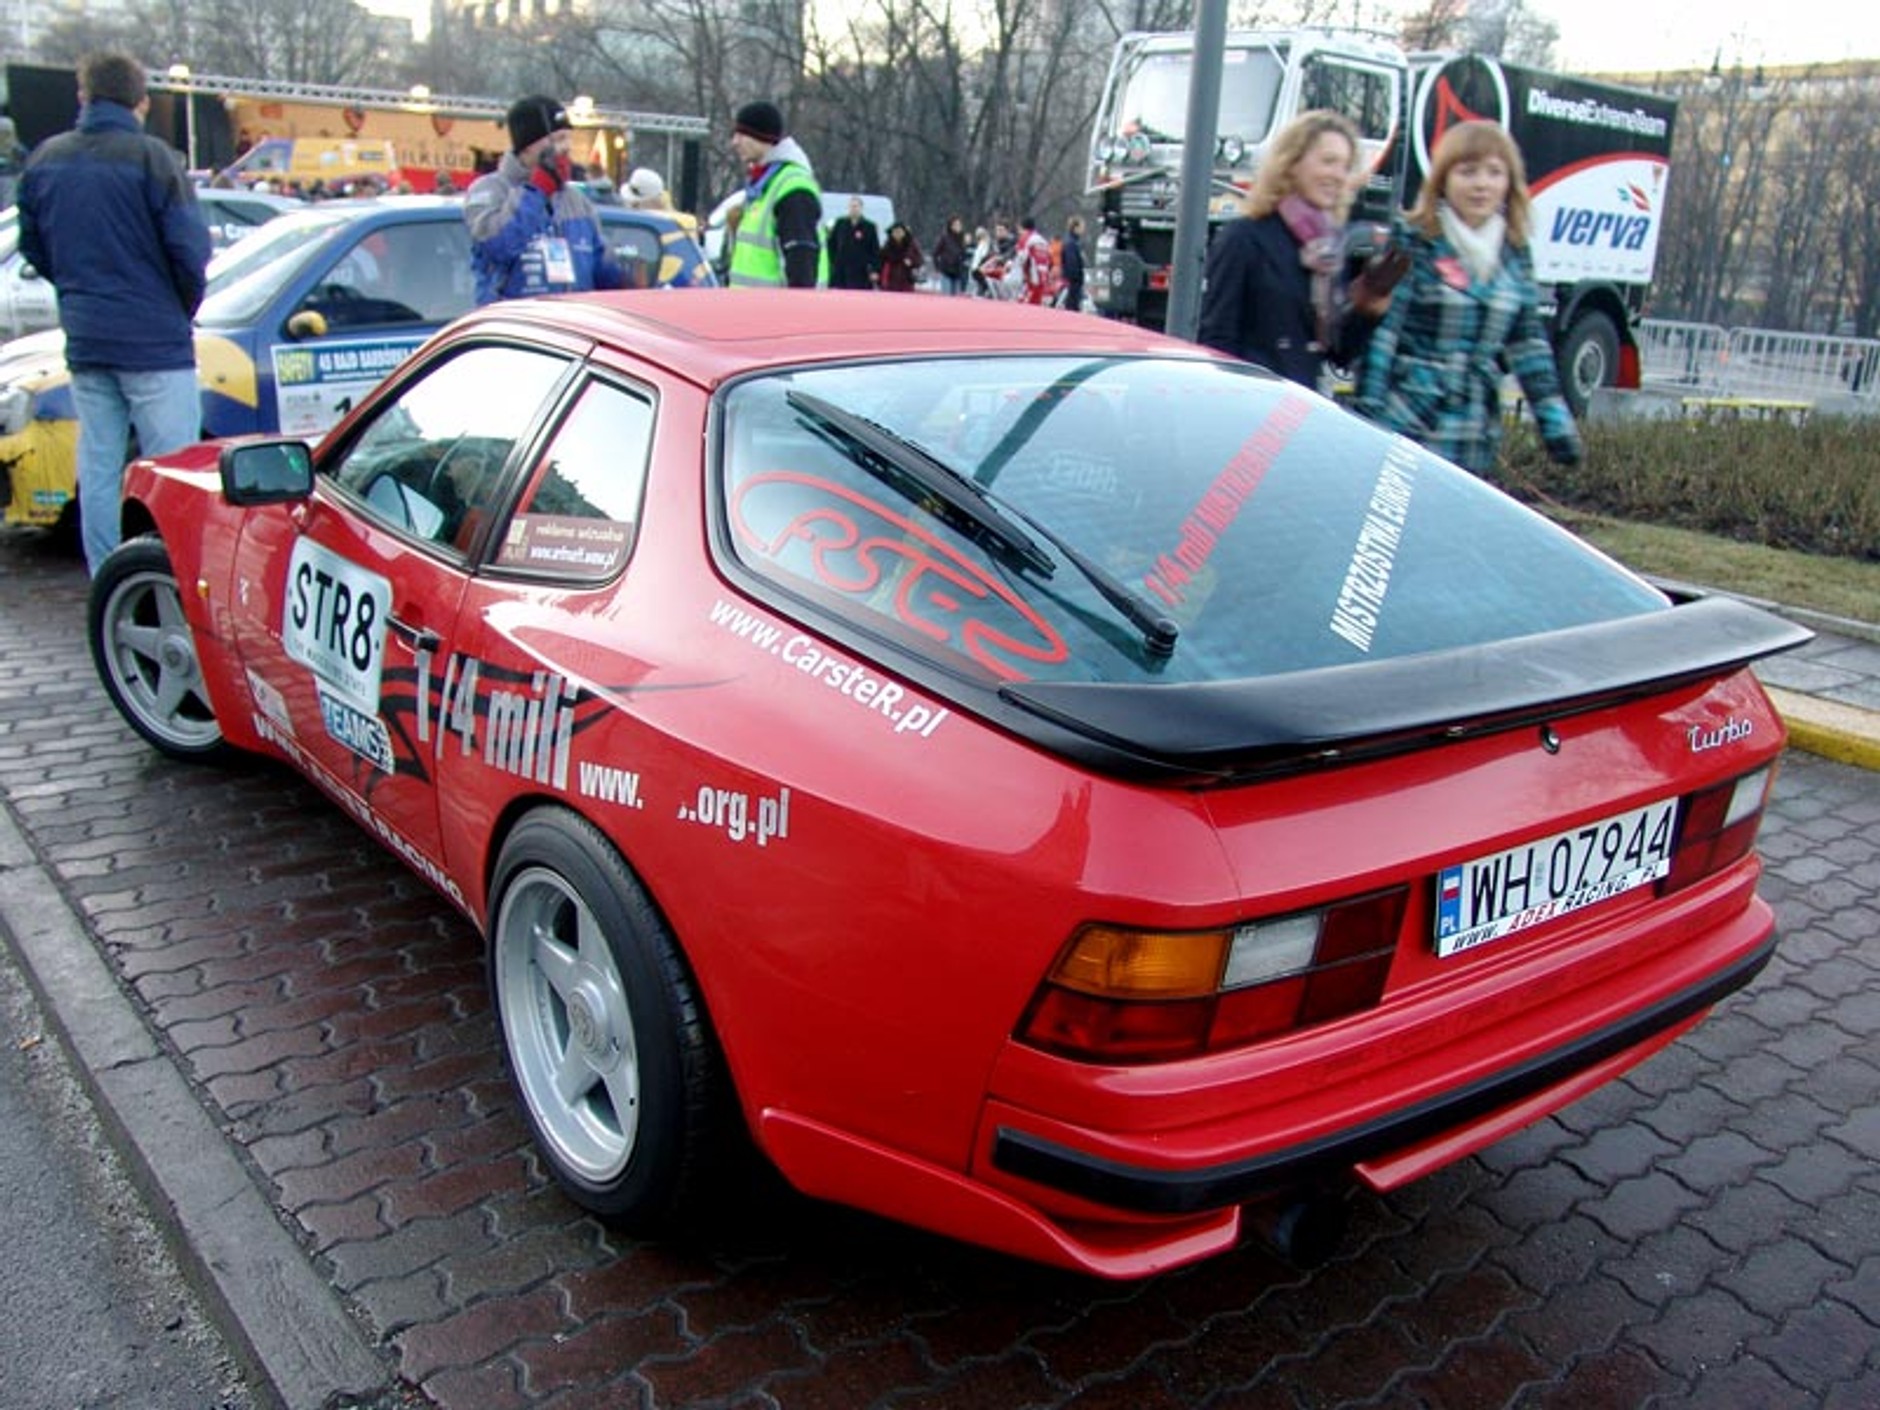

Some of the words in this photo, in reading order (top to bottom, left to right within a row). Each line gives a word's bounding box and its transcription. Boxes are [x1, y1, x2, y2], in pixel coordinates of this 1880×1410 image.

[1550, 206, 1651, 251] verva
[292, 561, 376, 672] STR8
[1329, 513, 1402, 653] MISTRZOSTWA
[414, 647, 479, 760] 1/4
[484, 670, 580, 791] mili
[709, 600, 949, 738] www.CarsteR.pl
[580, 761, 643, 809] www.
[1470, 847, 1535, 928] WH
[1548, 805, 1673, 900] 07944
[1508, 902, 1559, 932] ADEX
[1640, 865, 1660, 883] PL
